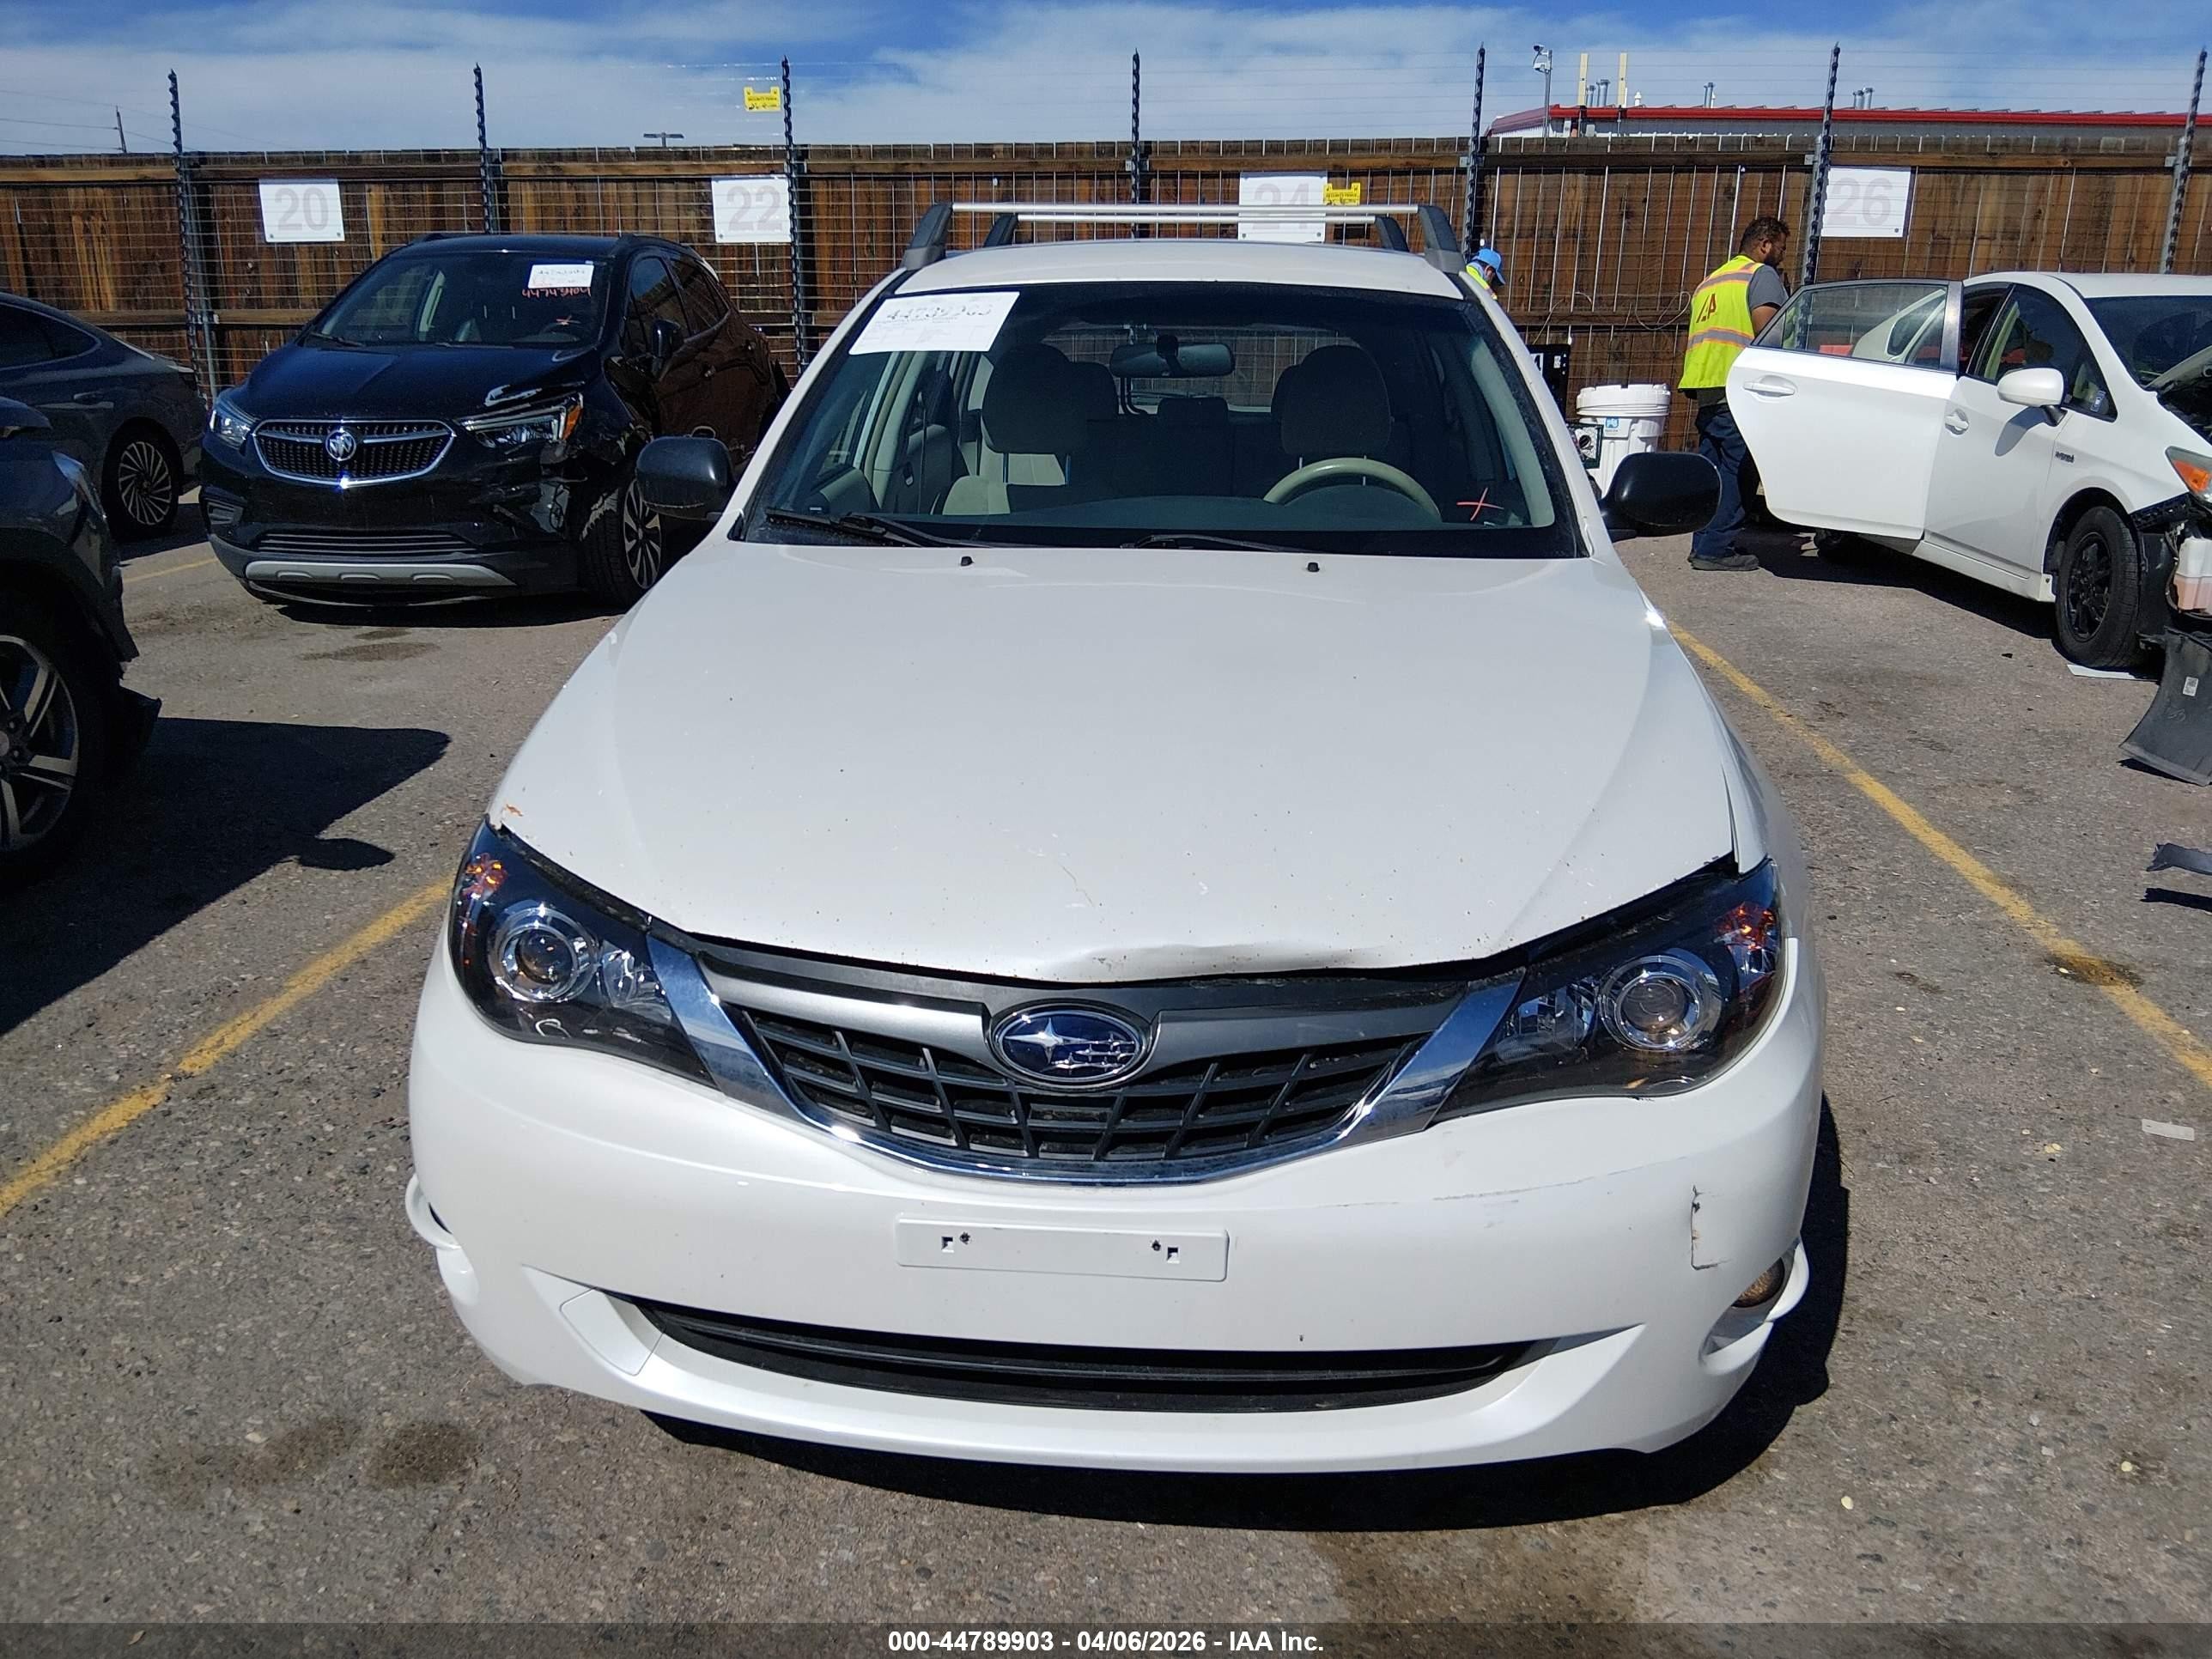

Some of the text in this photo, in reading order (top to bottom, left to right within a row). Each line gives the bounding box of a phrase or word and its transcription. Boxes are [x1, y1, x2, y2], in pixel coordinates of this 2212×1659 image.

[274, 187, 329, 232] 20
[726, 185, 783, 231] 22
[1252, 183, 1310, 229] 24
[1827, 177, 1893, 226] 26
